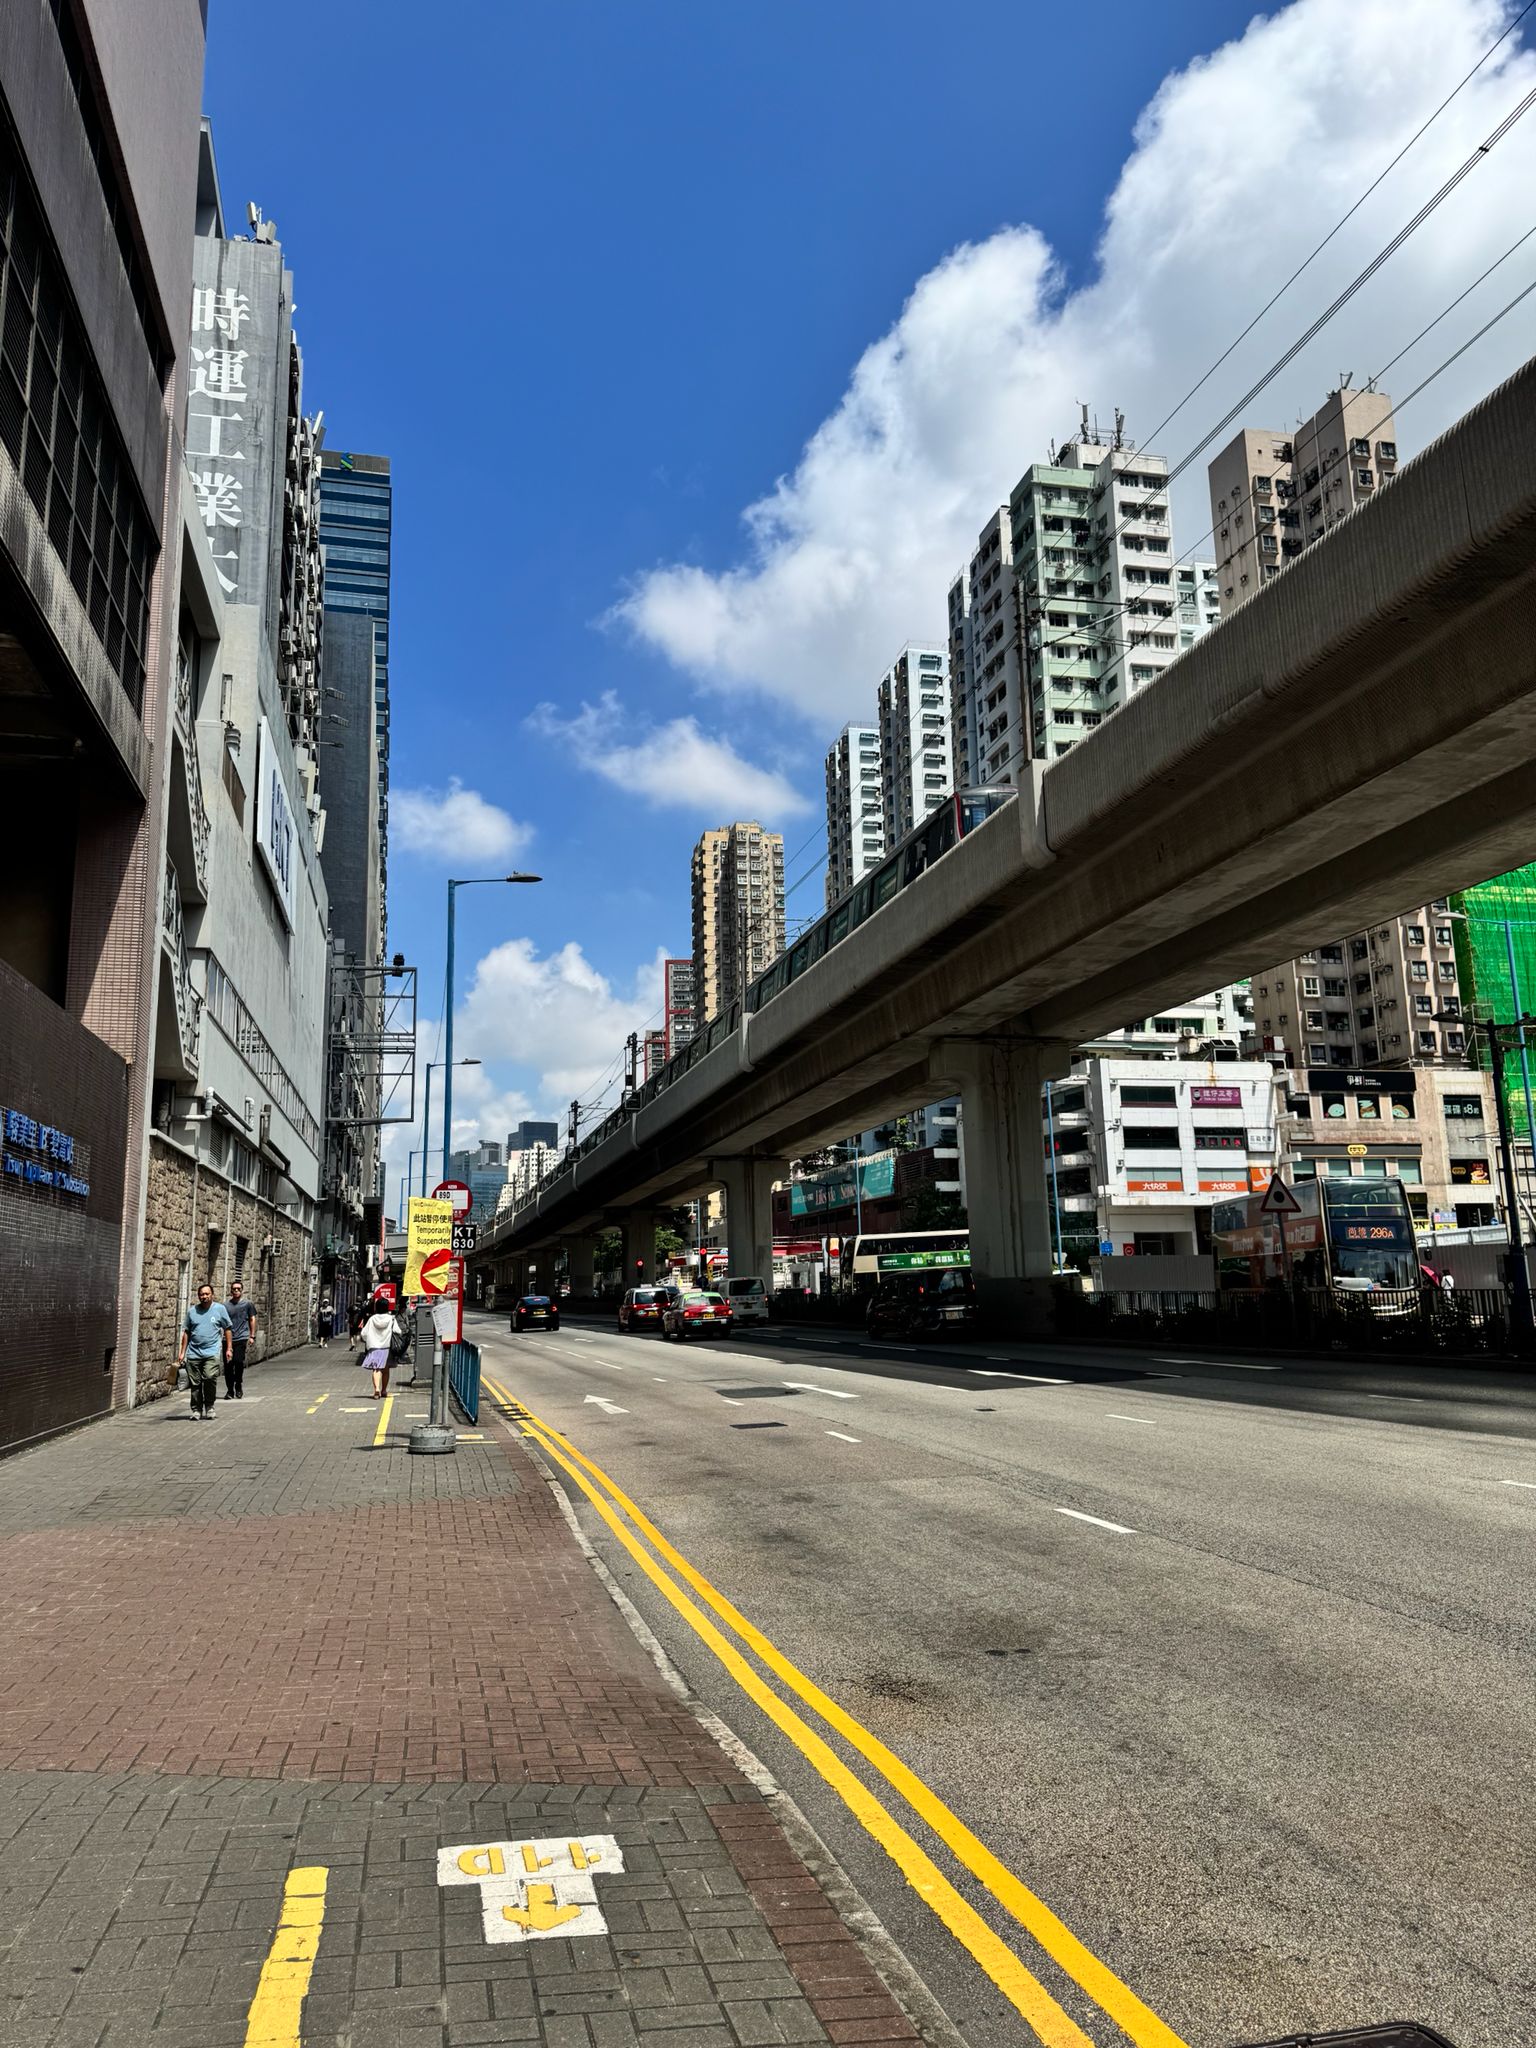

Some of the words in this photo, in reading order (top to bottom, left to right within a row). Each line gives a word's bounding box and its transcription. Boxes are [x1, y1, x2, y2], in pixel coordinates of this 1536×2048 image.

[416, 1225, 452, 1235] Temporarily
[1370, 1226, 1395, 1239] 296A
[416, 1236, 451, 1246] Suspended
[453, 1238, 474, 1249] 630
